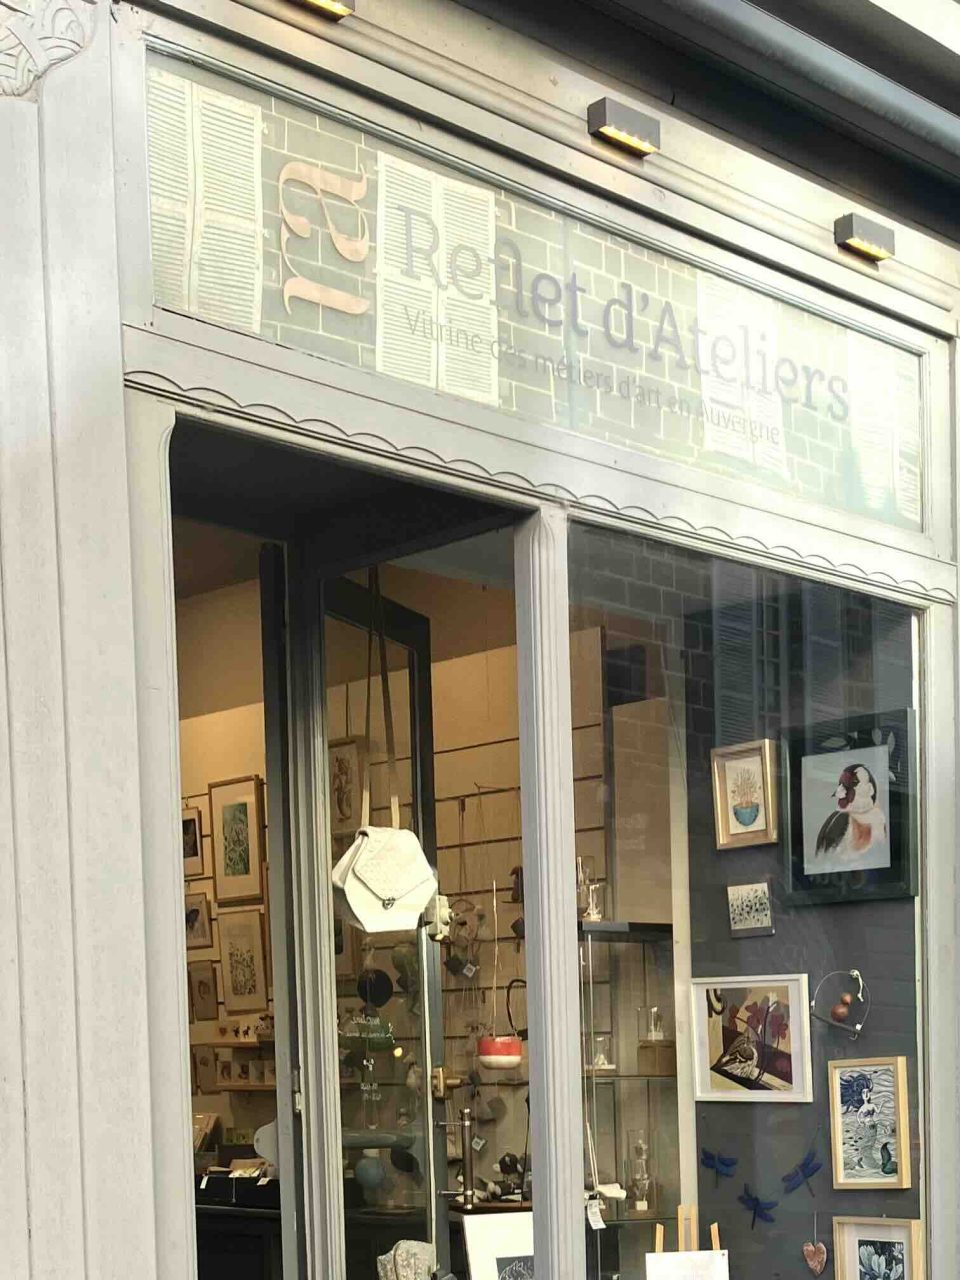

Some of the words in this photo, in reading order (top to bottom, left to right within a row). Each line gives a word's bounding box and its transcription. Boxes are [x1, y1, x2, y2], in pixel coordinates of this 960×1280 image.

[394, 204, 588, 337] Reflet
[603, 283, 849, 422] d'Ateliers
[404, 304, 482, 350] Vitrine
[490, 332, 524, 363] des
[535, 354, 612, 394] métiers
[619, 376, 661, 409] d'art
[698, 402, 780, 445] Auvergne
